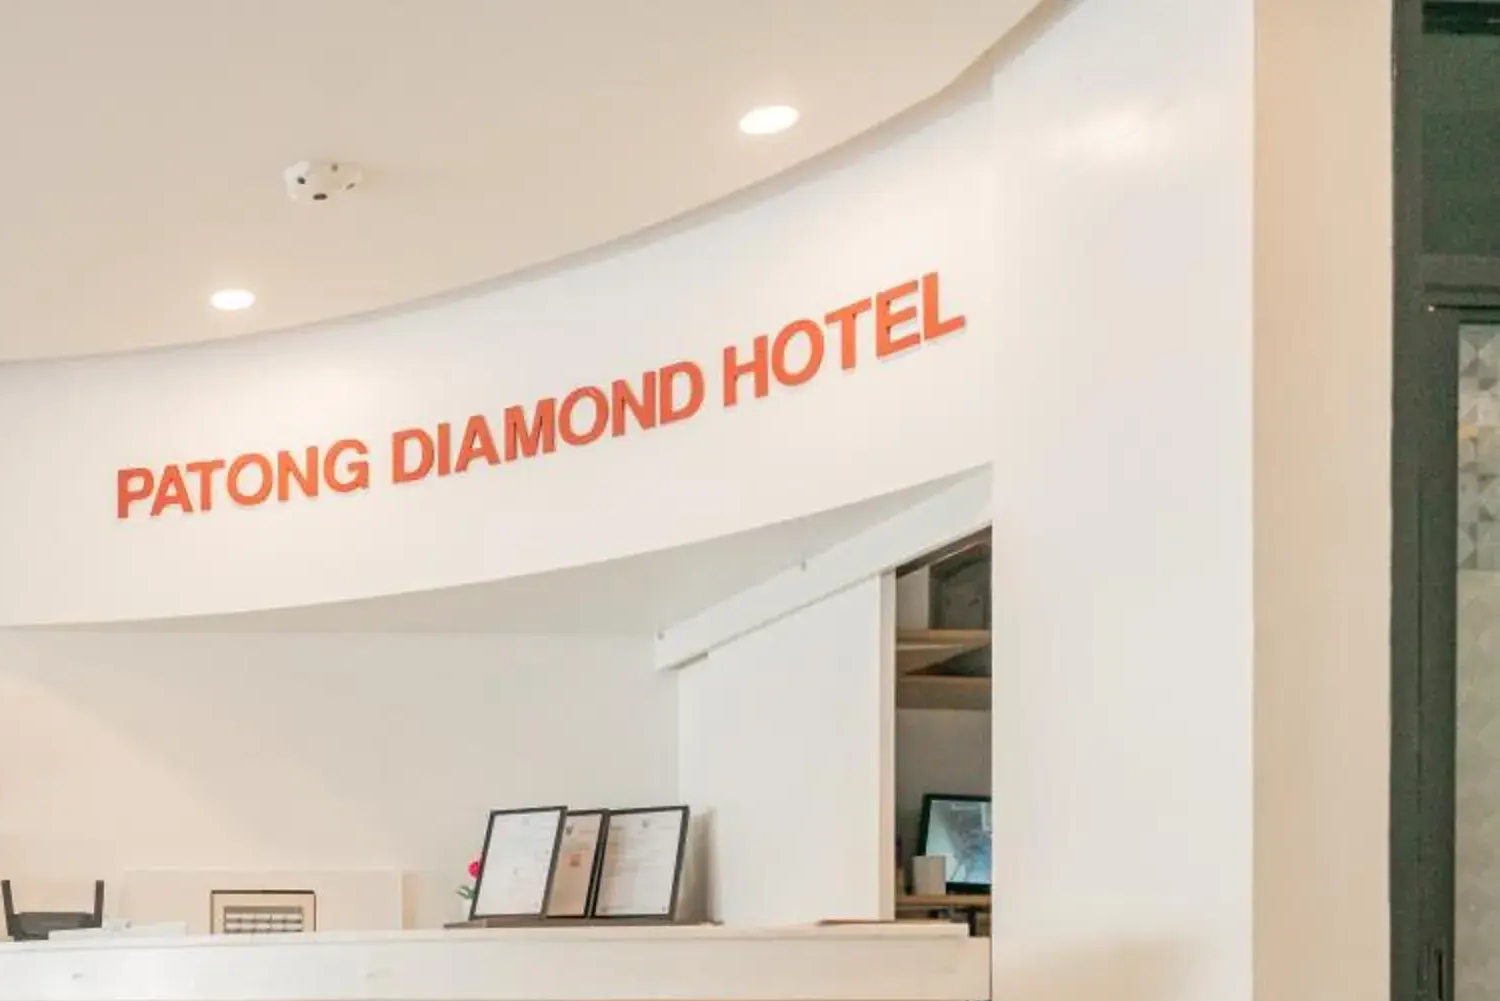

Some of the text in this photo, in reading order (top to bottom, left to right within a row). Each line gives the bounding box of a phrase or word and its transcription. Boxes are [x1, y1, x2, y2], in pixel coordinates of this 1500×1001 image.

[115, 271, 967, 520] PATONG DIAMOND HOTEL
